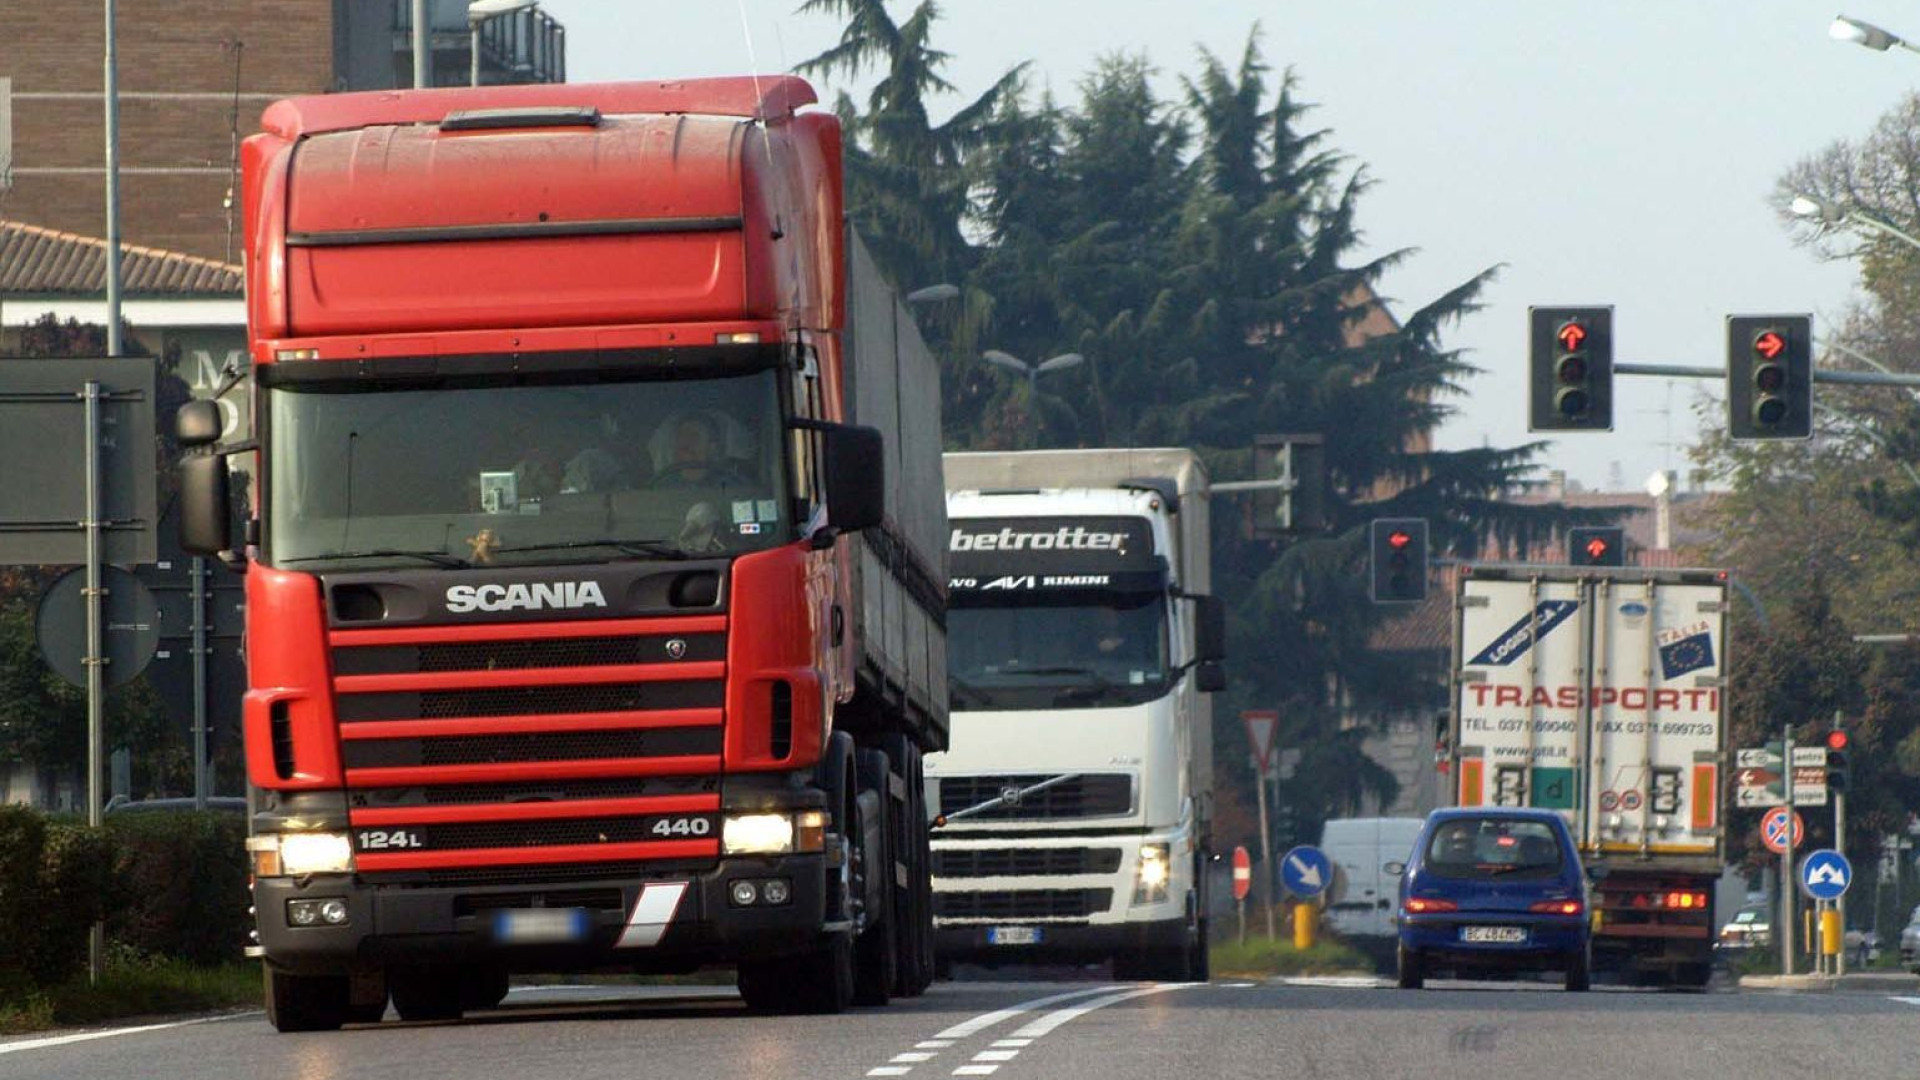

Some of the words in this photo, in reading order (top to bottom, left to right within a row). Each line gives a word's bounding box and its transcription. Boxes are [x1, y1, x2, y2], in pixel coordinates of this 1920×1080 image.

[191, 349, 244, 390] M
[950, 527, 1129, 550] betrotter
[980, 576, 1035, 590] AVI
[1042, 575, 1109, 586] RIMINI
[446, 581, 608, 612] SCANIA
[1489, 608, 1557, 663] LOGISTCA
[1468, 685, 1718, 712] TRASPORTI
[652, 817, 710, 836] 440
